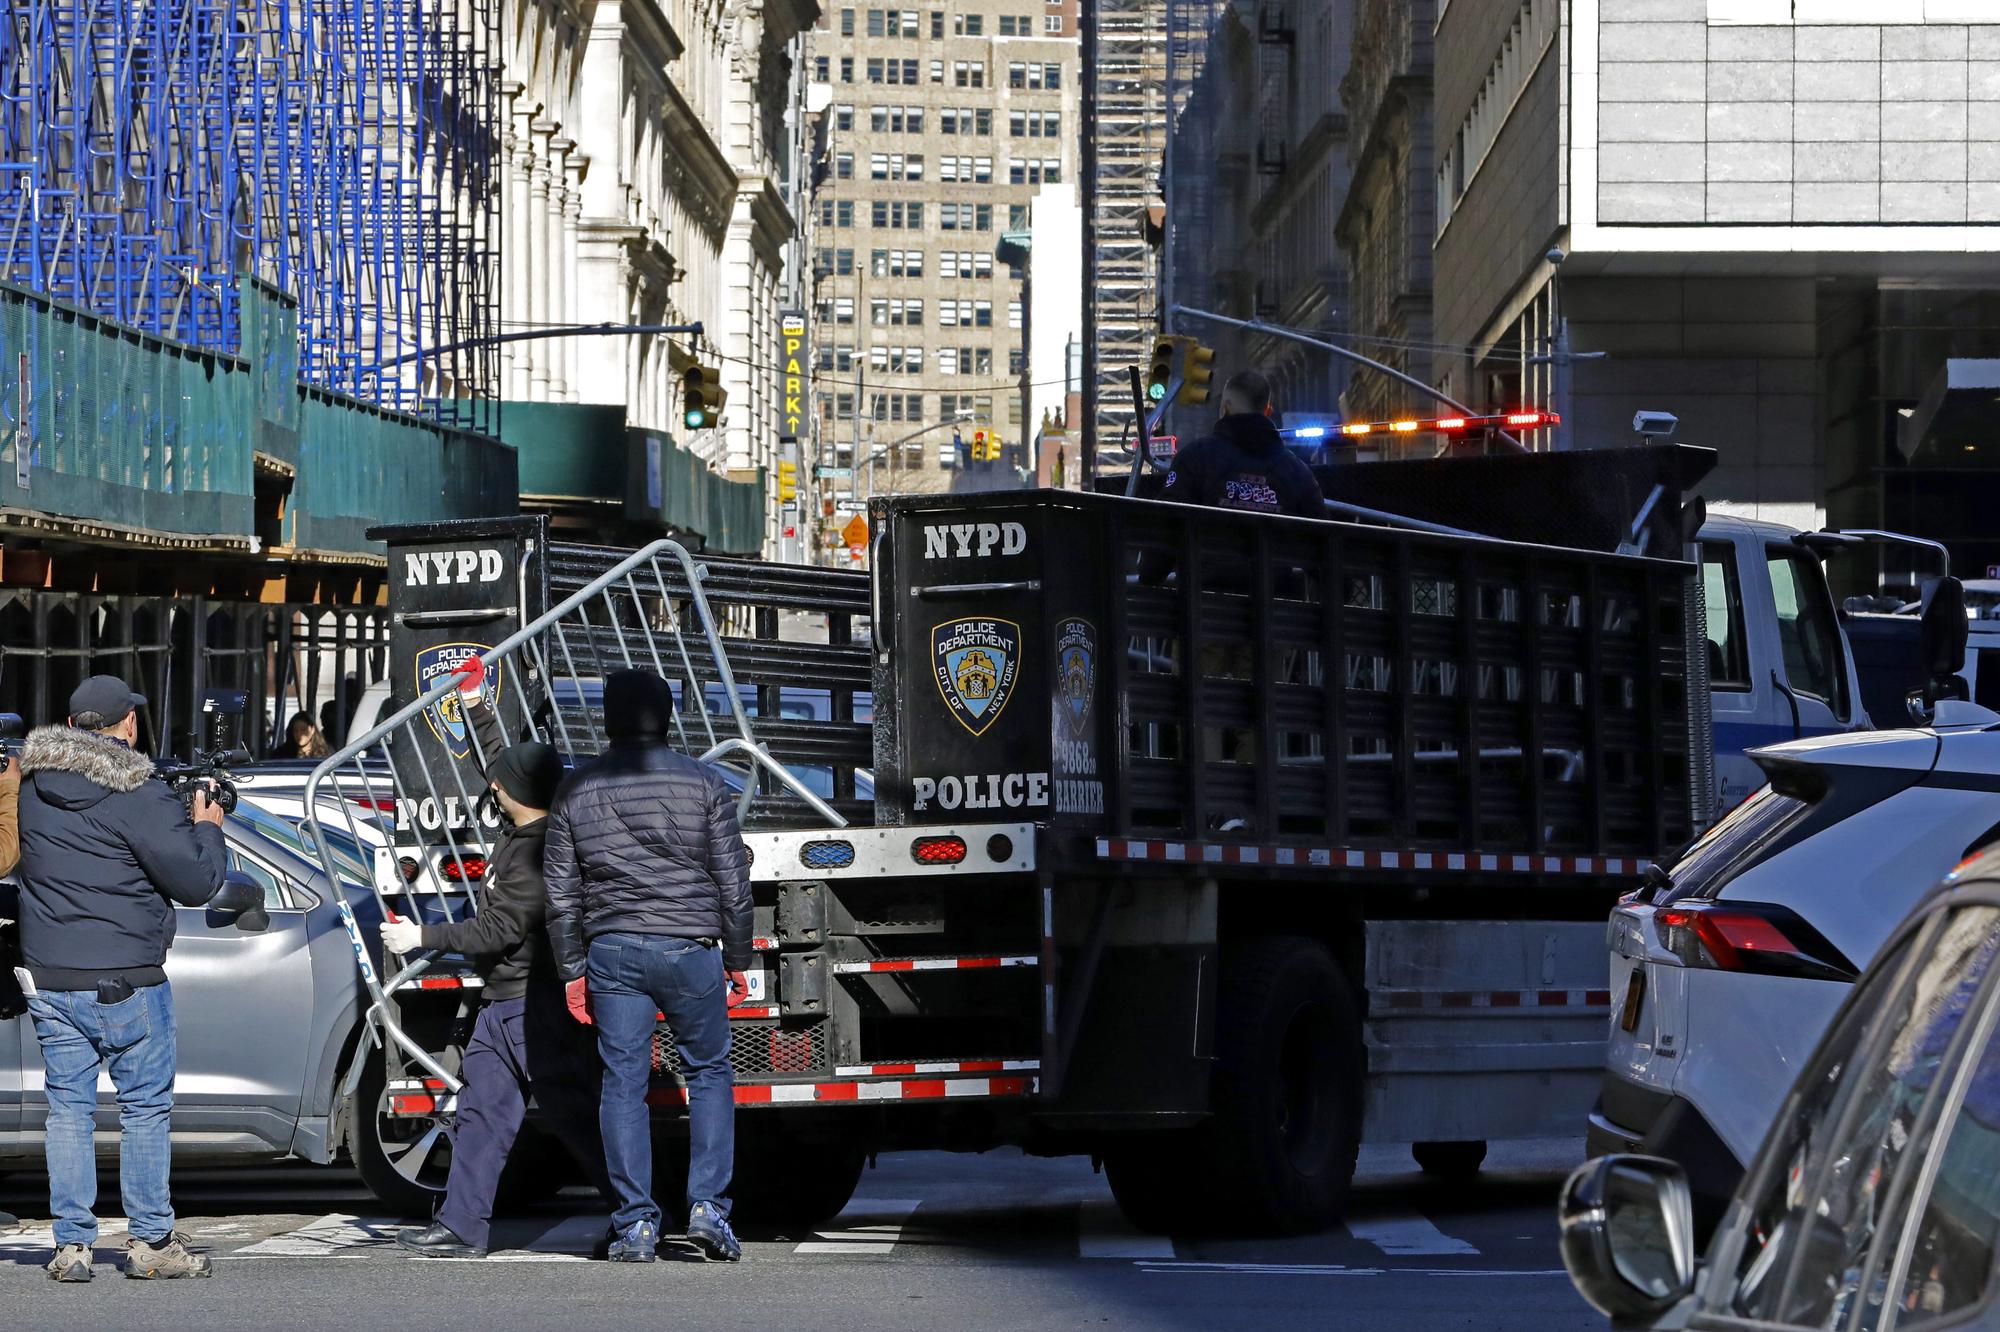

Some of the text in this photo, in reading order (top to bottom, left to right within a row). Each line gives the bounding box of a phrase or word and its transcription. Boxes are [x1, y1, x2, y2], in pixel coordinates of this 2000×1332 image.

[786, 338, 801, 414] PARK
[923, 521, 1027, 560] NYPD
[405, 549, 504, 587] NYPD
[938, 634, 1014, 656] DEPARTMENT
[955, 622, 996, 636] POLICE
[1058, 634, 1094, 654] DEPARTMENT
[1065, 622, 1086, 637] POLICE
[938, 666, 965, 711] CITY OF
[988, 659, 1015, 715] NEW YORK
[912, 772, 1049, 811] POLICE
[1055, 779, 1104, 814] BARRIER
[396, 795, 501, 831] POLIC
[336, 902, 372, 979] NYPD
